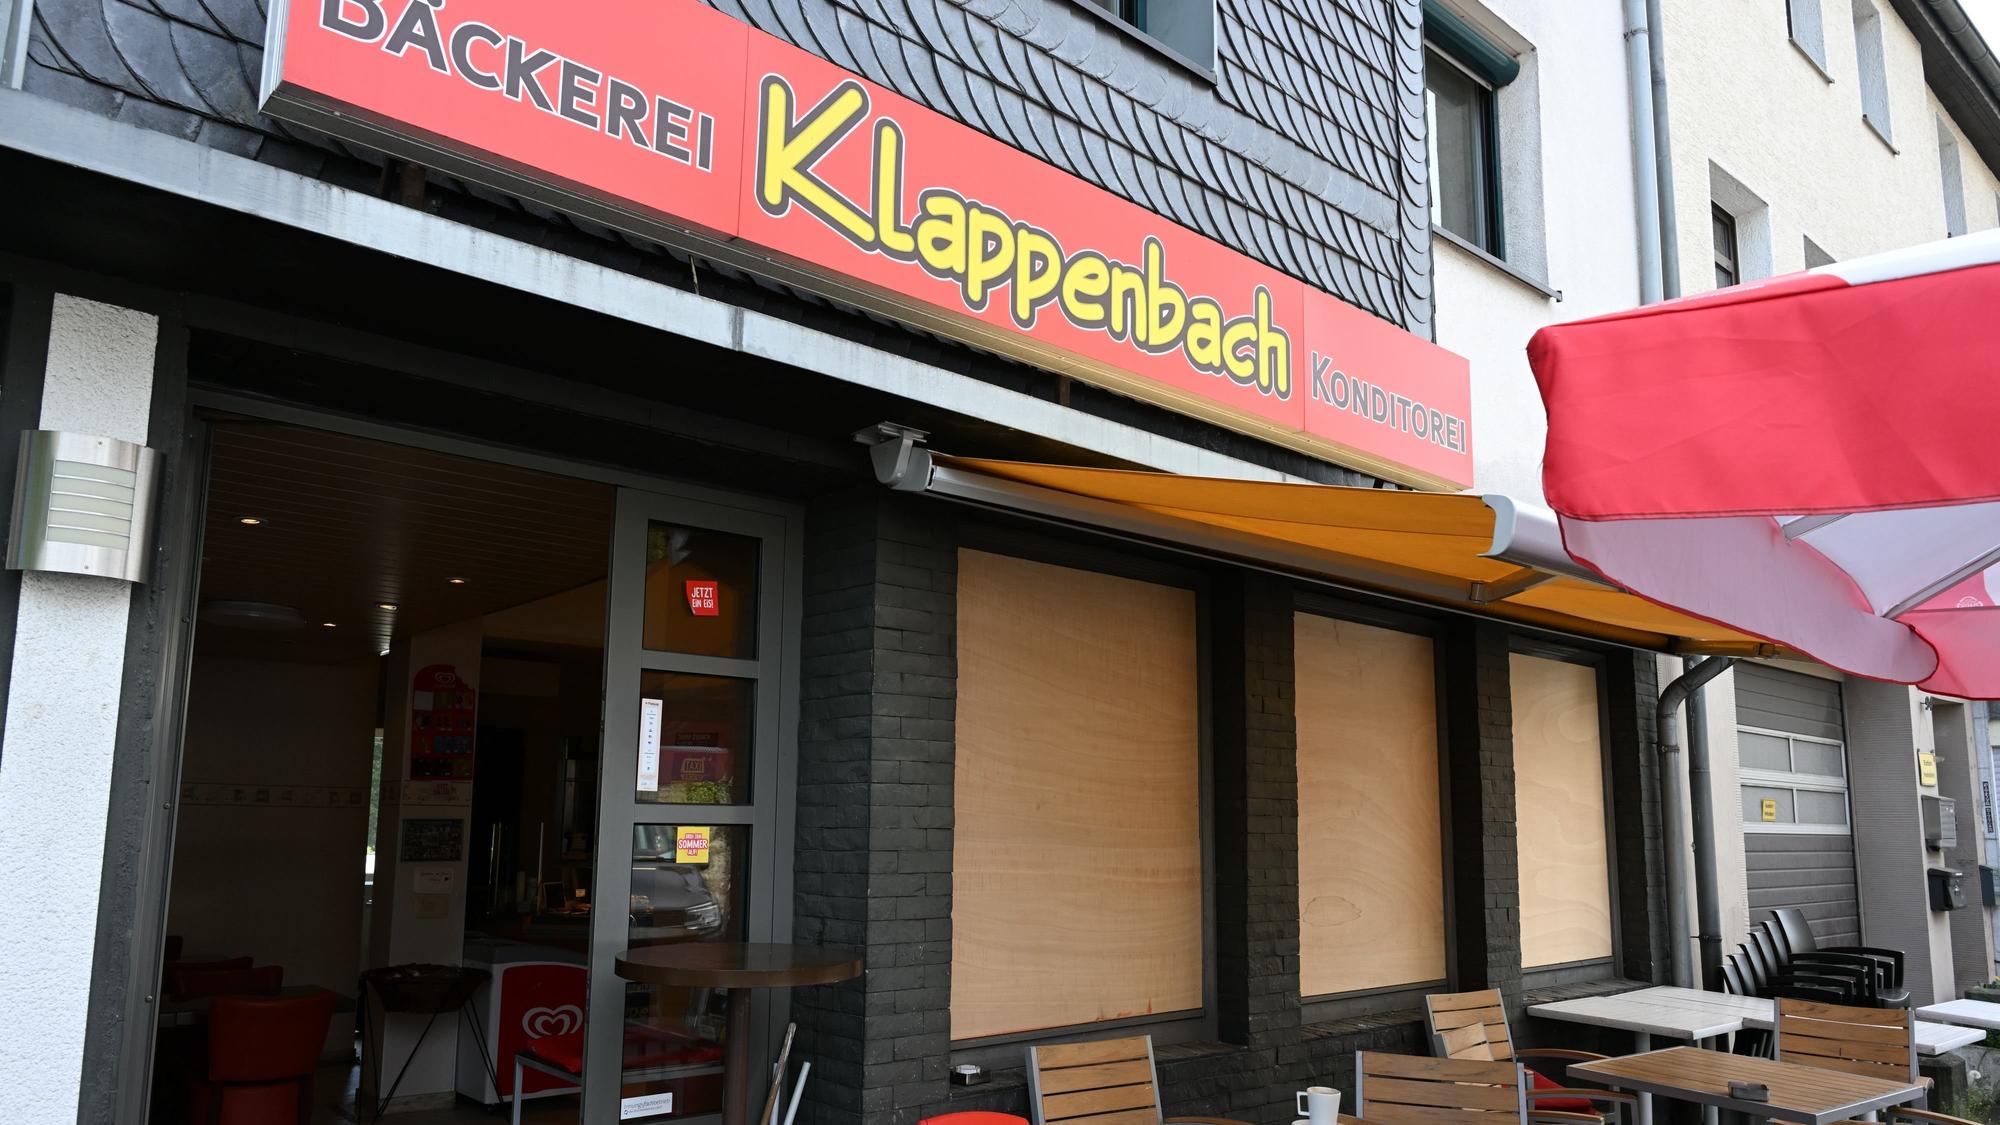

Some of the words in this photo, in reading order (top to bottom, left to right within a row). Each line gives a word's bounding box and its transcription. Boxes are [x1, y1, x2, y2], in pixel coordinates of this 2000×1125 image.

[755, 73, 1293, 402] Klappenbach
[1311, 350, 1467, 455] KONDITOREI
[691, 586, 714, 598] JETZT
[692, 598, 702, 608] EIN
[678, 839, 708, 849] SOMMER
